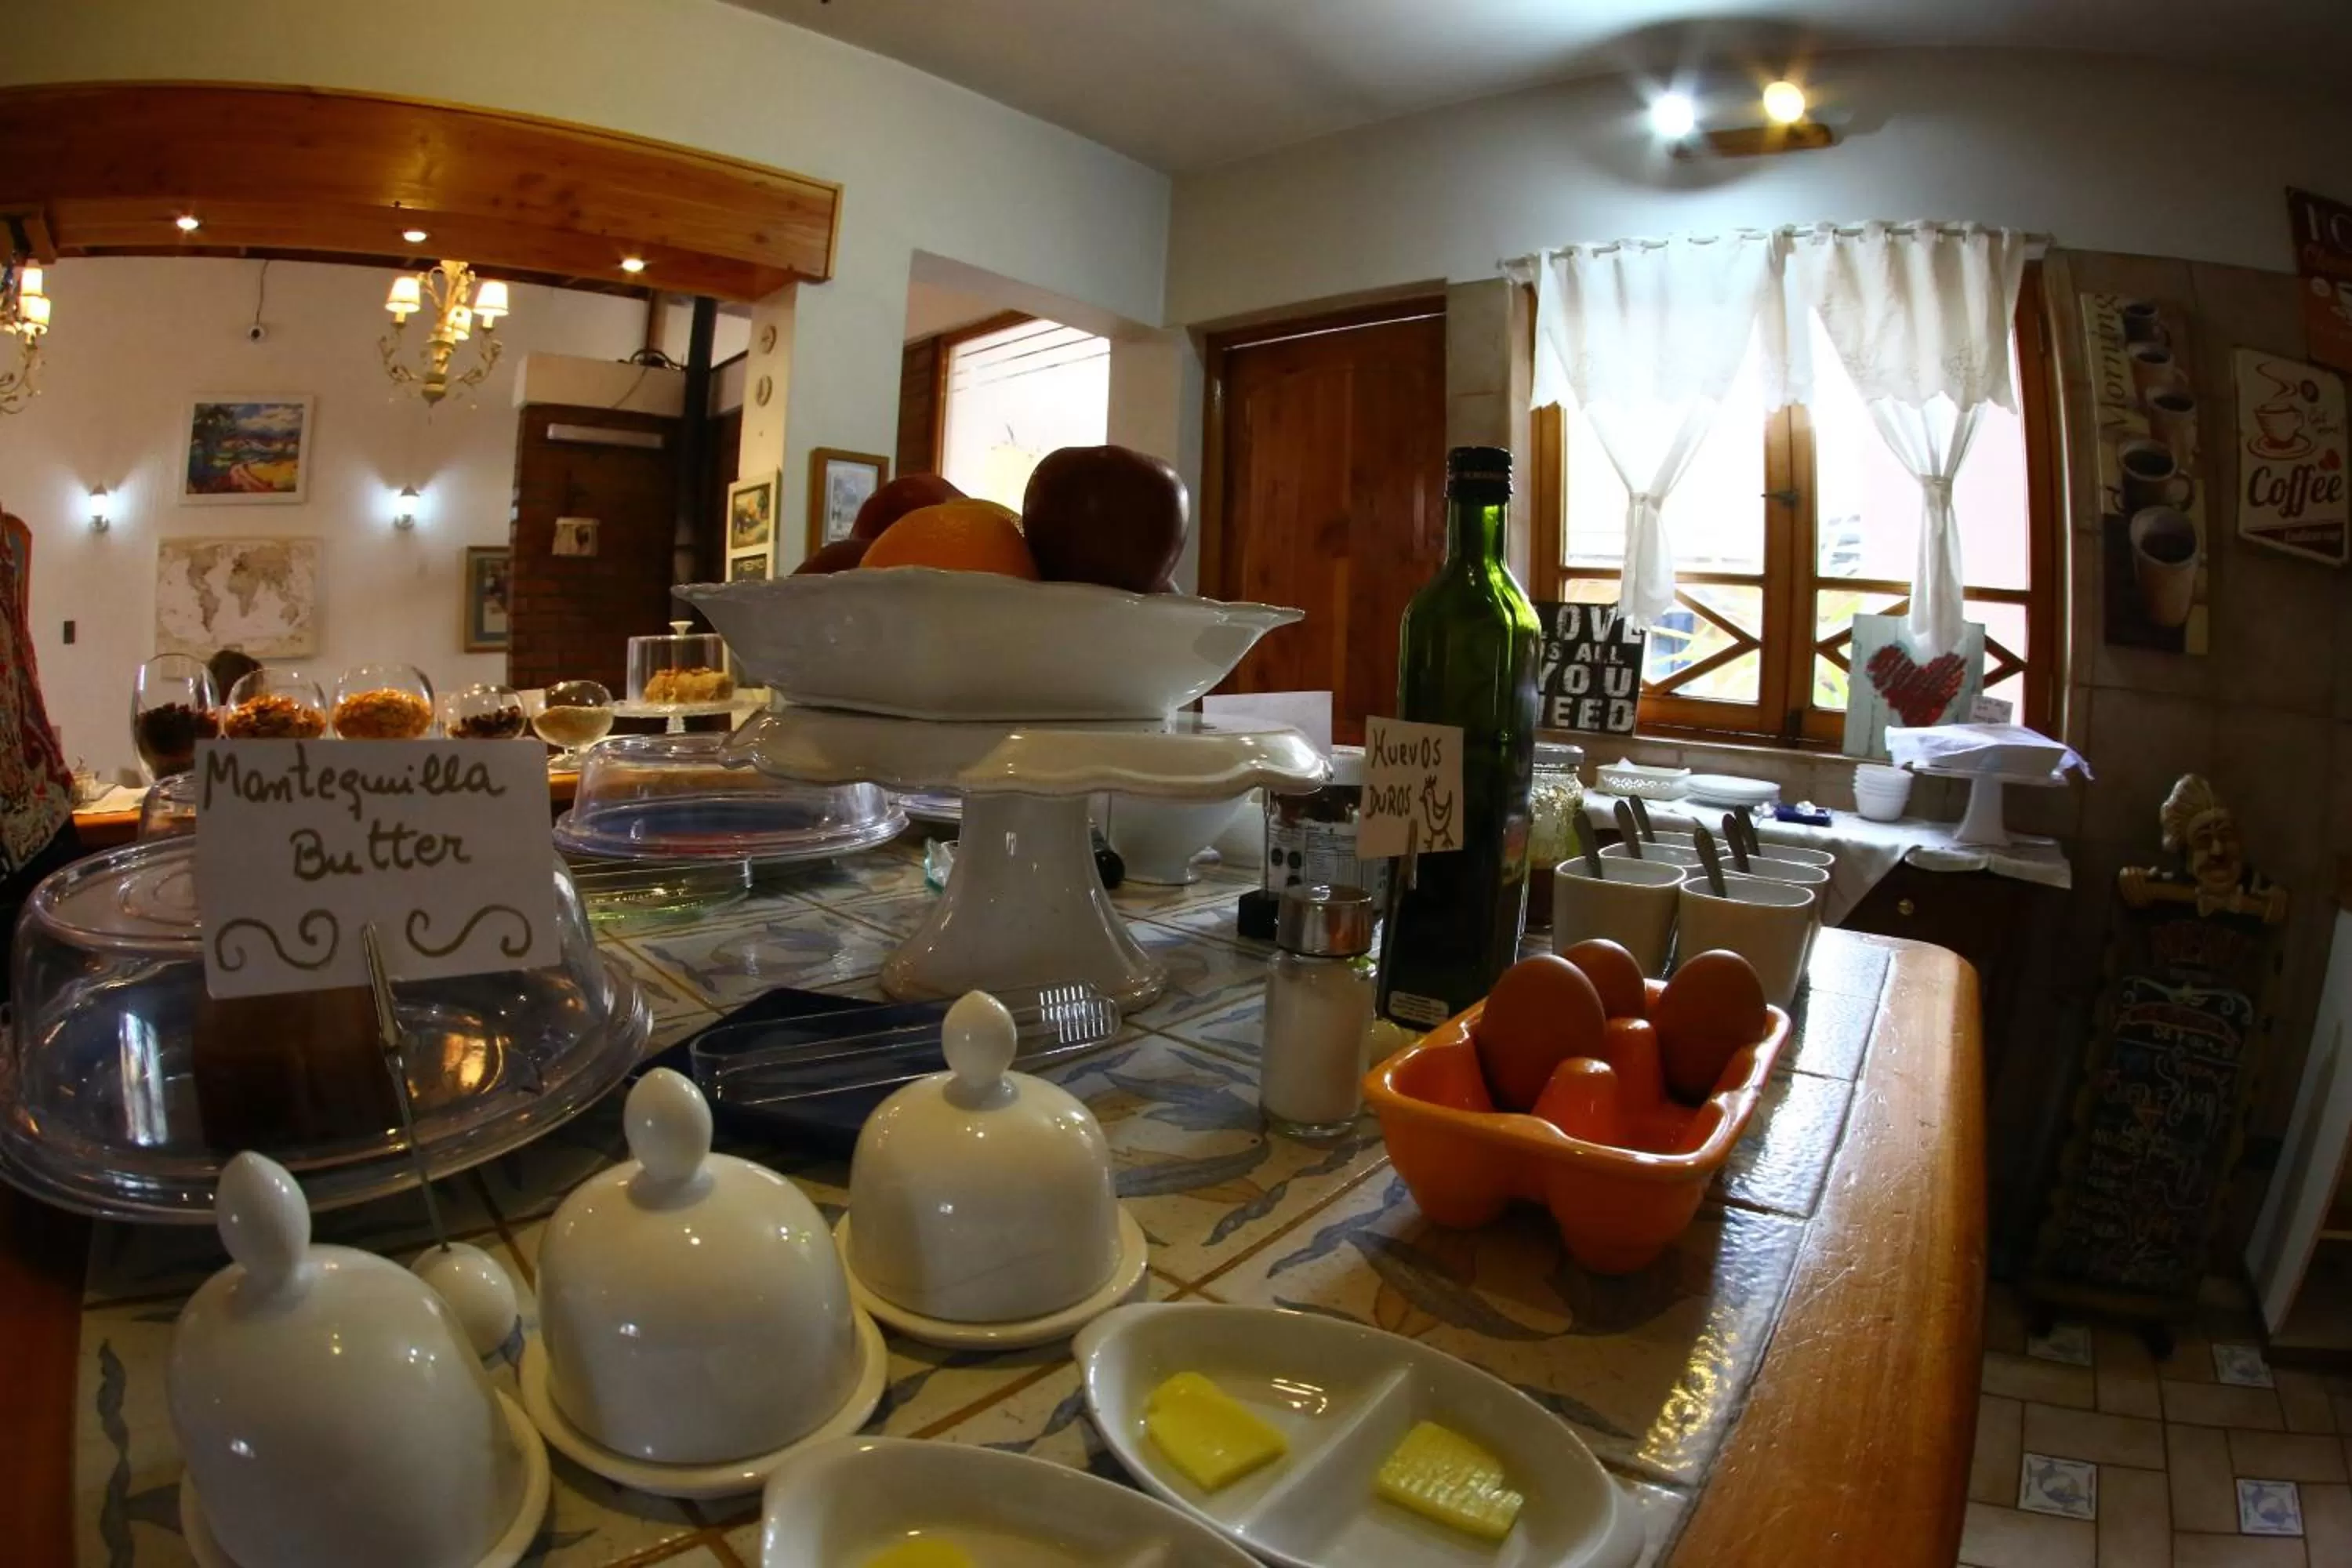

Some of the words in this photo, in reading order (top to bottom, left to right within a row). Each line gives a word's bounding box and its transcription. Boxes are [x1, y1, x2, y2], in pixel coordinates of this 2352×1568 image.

[2248, 463, 2344, 518] Coffee
[1540, 604, 1642, 644] OVE
[1536, 695, 1635, 731] EED
[204, 743, 506, 821] Mantequilla
[290, 819, 471, 881] Butter
